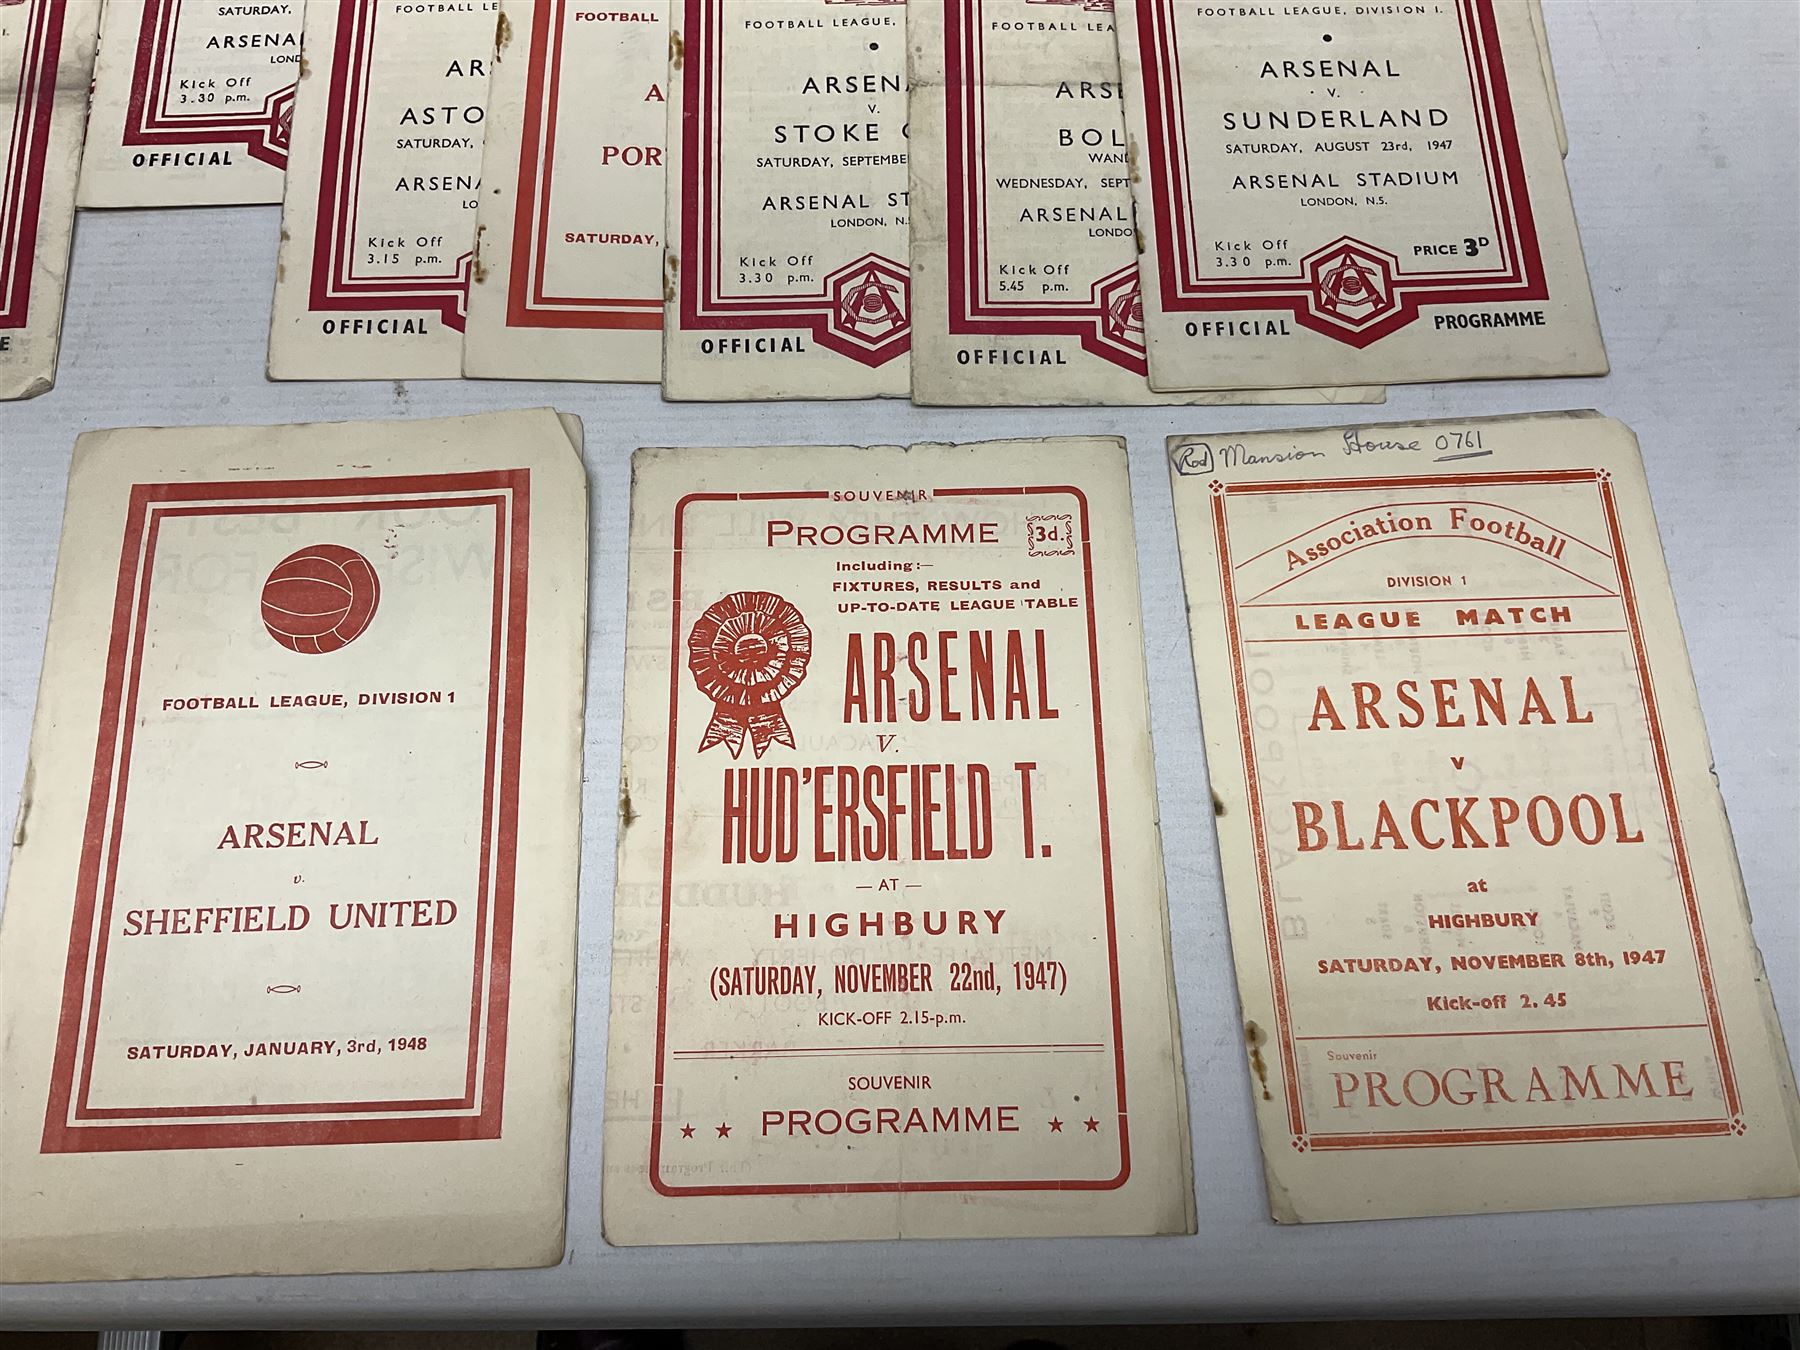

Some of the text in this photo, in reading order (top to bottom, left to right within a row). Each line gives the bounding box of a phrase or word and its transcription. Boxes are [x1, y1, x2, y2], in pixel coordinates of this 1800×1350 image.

[218, 5, 292, 16] SATURDAY,
[395, 3, 473, 13] FOOTBALL
[1197, 8, 1276, 17] FOOTBALL
[1355, 5, 1426, 15] DIVISION
[575, 12, 659, 23] FOOTBALL
[745, 19, 824, 30] FOOTBALL
[991, 21, 1078, 32] FOOTBALL
[1259, 59, 1401, 79] ARSENAL
[226, 77, 251, 88] Off
[802, 74, 910, 95] ARSEN
[180, 92, 250, 104] 3.30 p.m.
[1222, 108, 1449, 131] SUNDERLAND
[774, 123, 880, 144] STOKE
[396, 137, 473, 149] SATURDAY,
[1225, 139, 1454, 155] SATURDAY, AUGUST 23rd, 1947
[132, 151, 233, 167] OFFICIAL
[756, 153, 909, 169] SATURDAY, SEPTEMBE
[996, 178, 1088, 189] WEDNESDAY,
[1232, 171, 1460, 191] ARSENAL STADIUM
[762, 193, 870, 212] ARSENAL
[1300, 197, 1358, 207] LONDON,
[830, 217, 887, 228] LONDON,
[1019, 206, 1128, 223] ARSENAL
[368, 236, 443, 249] Kick Off
[565, 232, 659, 247] SATURDAY,
[1214, 239, 1289, 252] Kick Off
[1413, 244, 1458, 256] PRICE
[367, 253, 442, 266] 3.15 p.m.
[739, 255, 814, 268] Kick Off
[1215, 256, 1292, 269] 3.30 p.m.
[999, 264, 1070, 276] Kick Off
[739, 272, 814, 285] 3.30 p.m.
[999, 280, 1069, 294] 5.45 p.m.
[322, 319, 429, 335] OFFICIAL
[1184, 310, 1546, 337] OFFICIAL PROGRAMME
[700, 337, 806, 354] OFFICIAL
[956, 349, 1067, 366] OFFICIAL
[1220, 445, 1326, 468] Mansion
[1435, 431, 1483, 451] 0761
[1284, 507, 1568, 572] Association Football
[832, 579, 1041, 594] FIXTURES, RESULTS and
[1386, 575, 1468, 588] DIVISION 1
[837, 597, 1079, 614] UP-TO-DATE LEAGUE TABLE
[1294, 606, 1572, 631] LEAGUE MATCH
[843, 628, 1060, 724] ARSENAL
[162, 691, 456, 711] FOOTBALL LEAGUE, DIVISION 1
[1307, 675, 1594, 732] ARSENAL
[1014, 761, 1053, 859] T.
[1292, 792, 1645, 853] BLACKPOOL
[216, 820, 379, 850] ARSENAL
[292, 875, 306, 885] v.
[878, 878, 899, 891] AT
[1467, 878, 1488, 894] at
[122, 900, 458, 937] SHEFFIELD UNITED
[773, 909, 1007, 939] HIGHBURY
[1427, 911, 1539, 930] HIGHBURY
[1317, 949, 1666, 975] SATURDAY, NOVEMBER 8th, 1947
[709, 960, 1068, 1001] (SATURDAY, NOVEMBER 22nd, 1947)
[1426, 994, 1508, 1012] Kick-off
[818, 1009, 967, 1027] KICK-OFF 2.15-p.m.
[126, 1037, 428, 1061] SATURDAY, JANUARY, 3rd, 1948
[1327, 1048, 1378, 1062] Souvenir
[848, 1074, 932, 1091] SOUVENIR
[1330, 1060, 1694, 1110] PROGRAMME
[760, 1106, 1021, 1137] PROGRAMME
